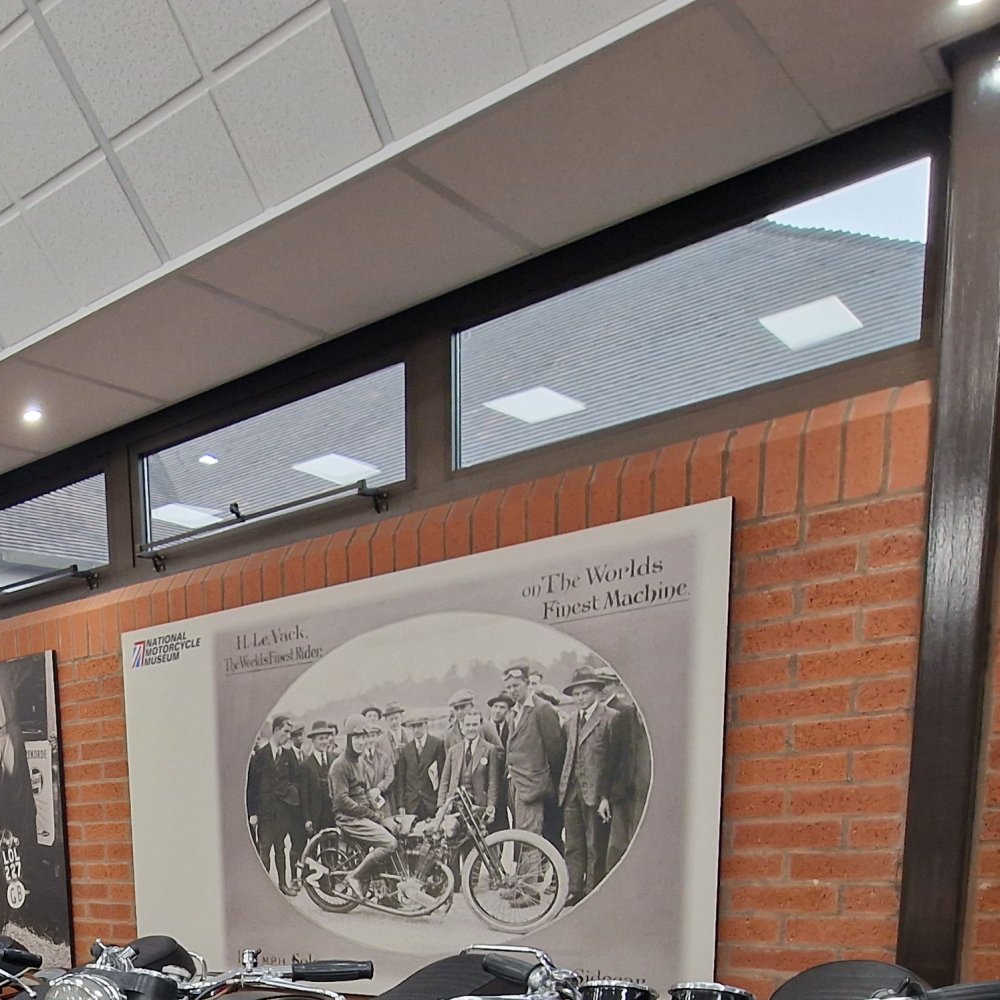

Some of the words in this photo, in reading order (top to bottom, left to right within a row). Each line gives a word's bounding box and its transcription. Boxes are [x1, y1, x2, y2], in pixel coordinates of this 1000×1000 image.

[521, 583, 542, 599] on
[541, 571, 581, 595] The
[585, 555, 664, 587] Worlds
[542, 595, 601, 621] Finest
[145, 637, 202, 657] MOTORCYCLE
[146, 631, 187, 647] NATIONAL
[144, 652, 180, 667] MUSEUM
[2, 846, 21, 865] LOL
[4, 860, 22, 881] 227
